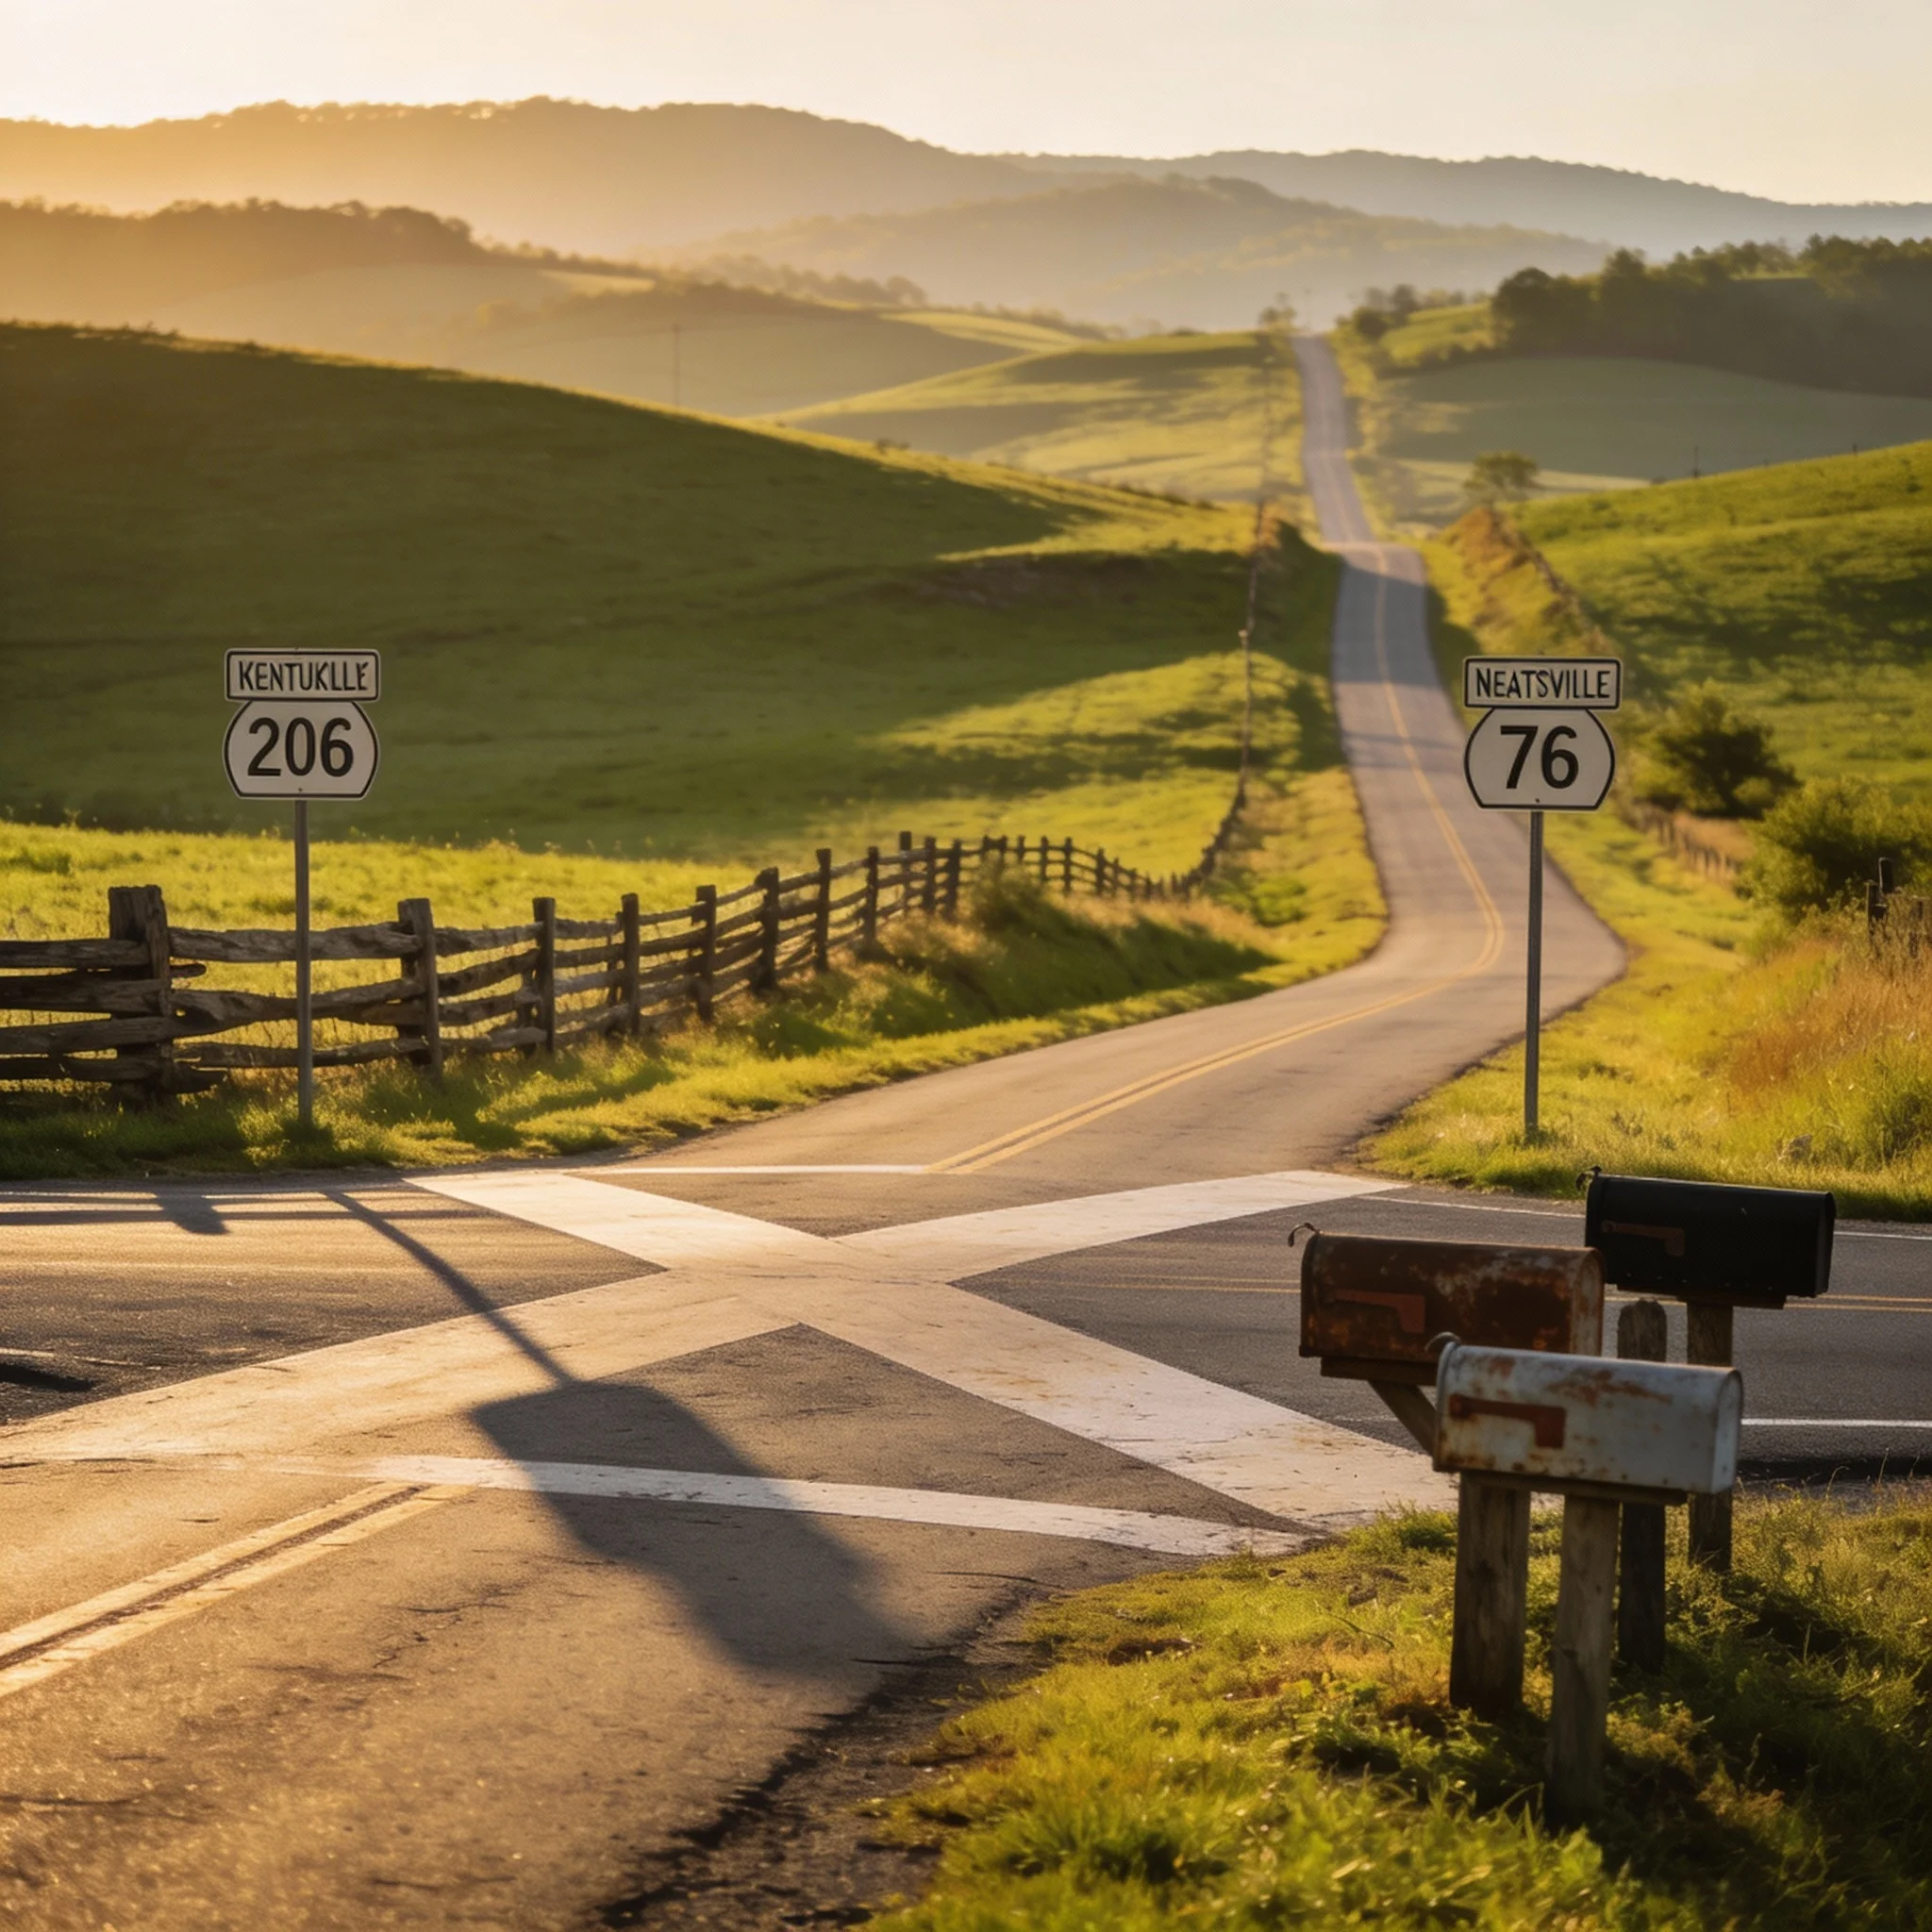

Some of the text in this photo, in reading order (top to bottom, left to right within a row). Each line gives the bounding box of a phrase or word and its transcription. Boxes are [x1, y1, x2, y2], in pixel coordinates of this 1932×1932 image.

[1475, 668, 1610, 699] NEATSVILLE
[247, 717, 354, 777] 206
[1500, 725, 1579, 790] 76
